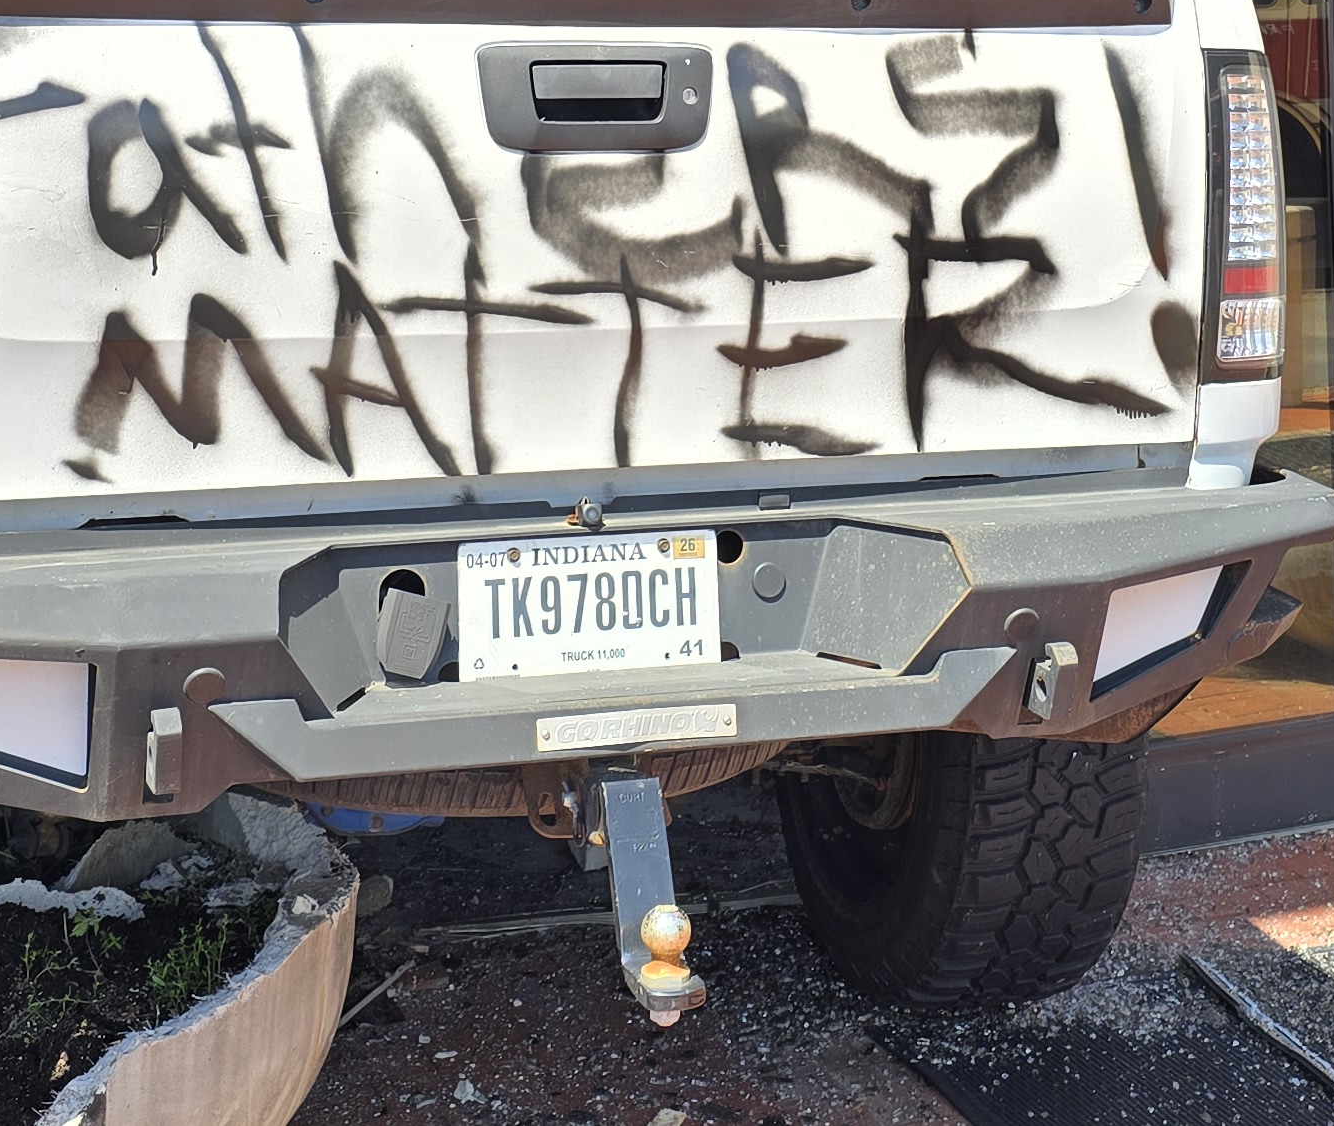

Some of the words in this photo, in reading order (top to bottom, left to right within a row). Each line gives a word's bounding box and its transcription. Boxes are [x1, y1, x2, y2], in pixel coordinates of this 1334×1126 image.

[63, 224, 1171, 479] MATTER
[680, 537, 696, 552] 26
[466, 551, 507, 569] 04-07
[531, 542, 647, 567] INDIANA
[561, 650, 595, 663] TRUCK
[597, 648, 626, 661] 11,000
[679, 639, 704, 657] 41
